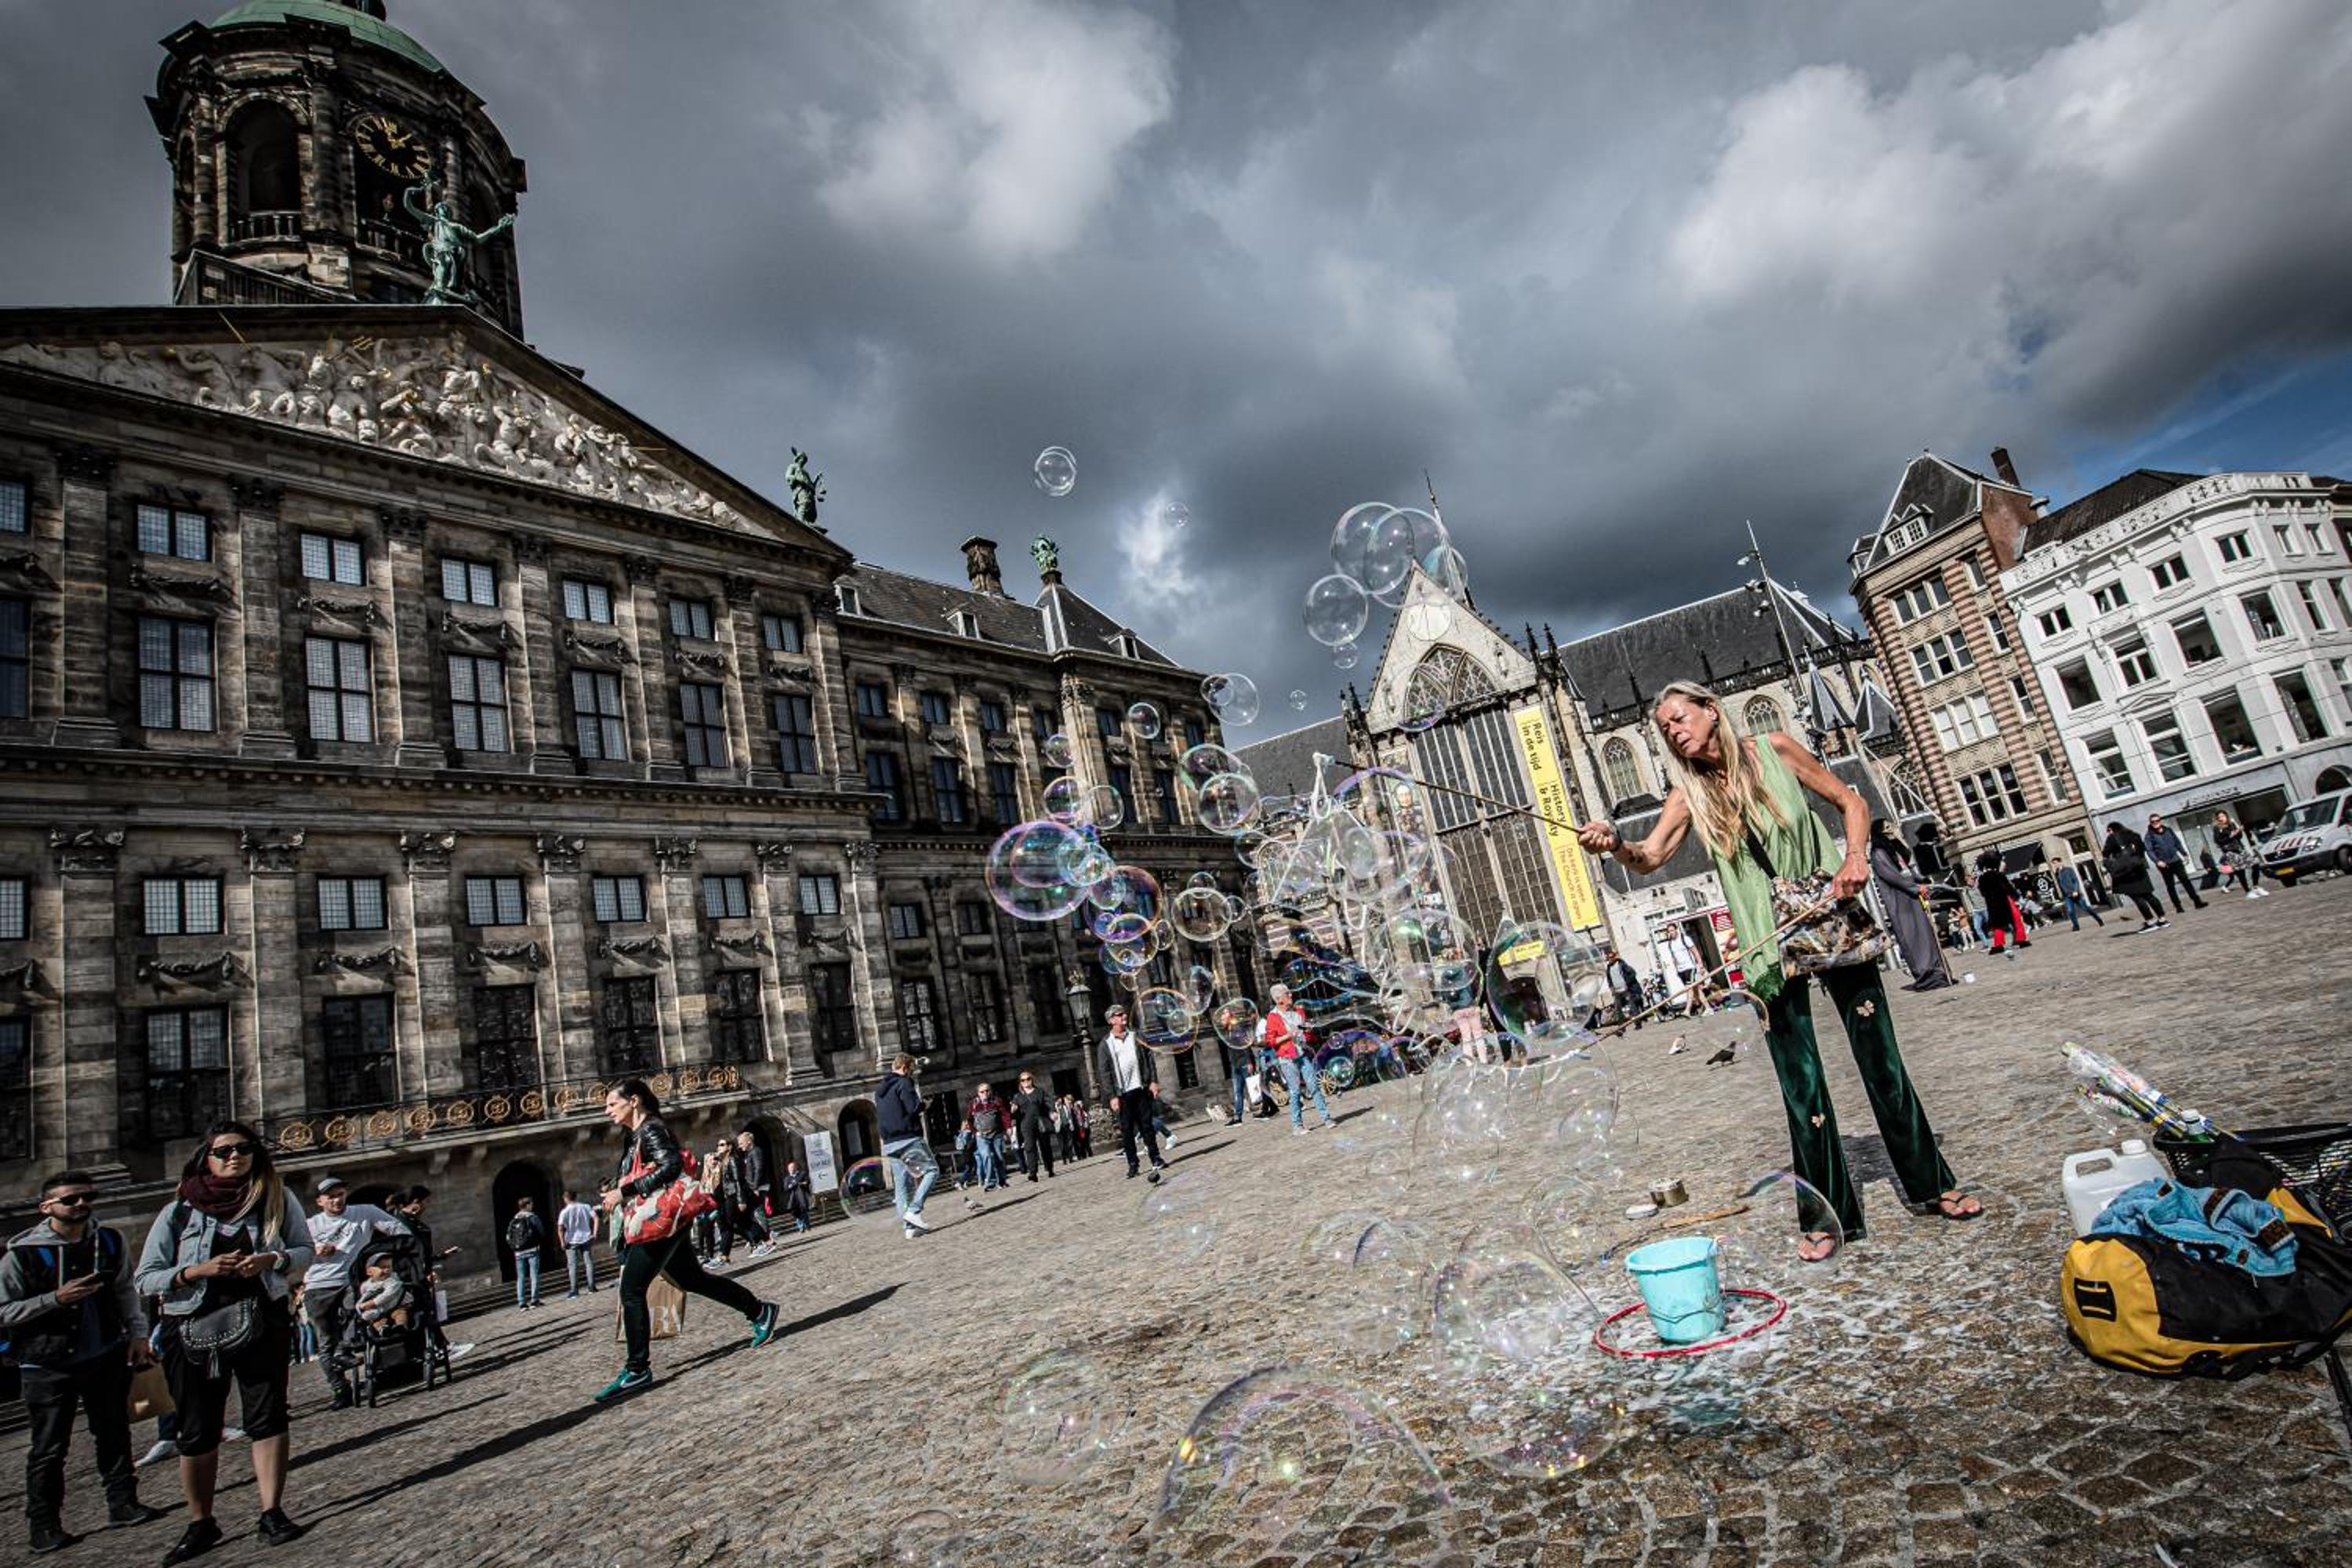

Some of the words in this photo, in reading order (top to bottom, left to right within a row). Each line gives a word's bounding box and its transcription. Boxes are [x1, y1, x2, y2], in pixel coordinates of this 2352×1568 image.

[1522, 726, 1530, 736] in
[1526, 738, 1534, 751] de
[1530, 752, 1542, 771] tijd
[1533, 722, 1543, 744] Reis
[1551, 785, 1566, 822] History
